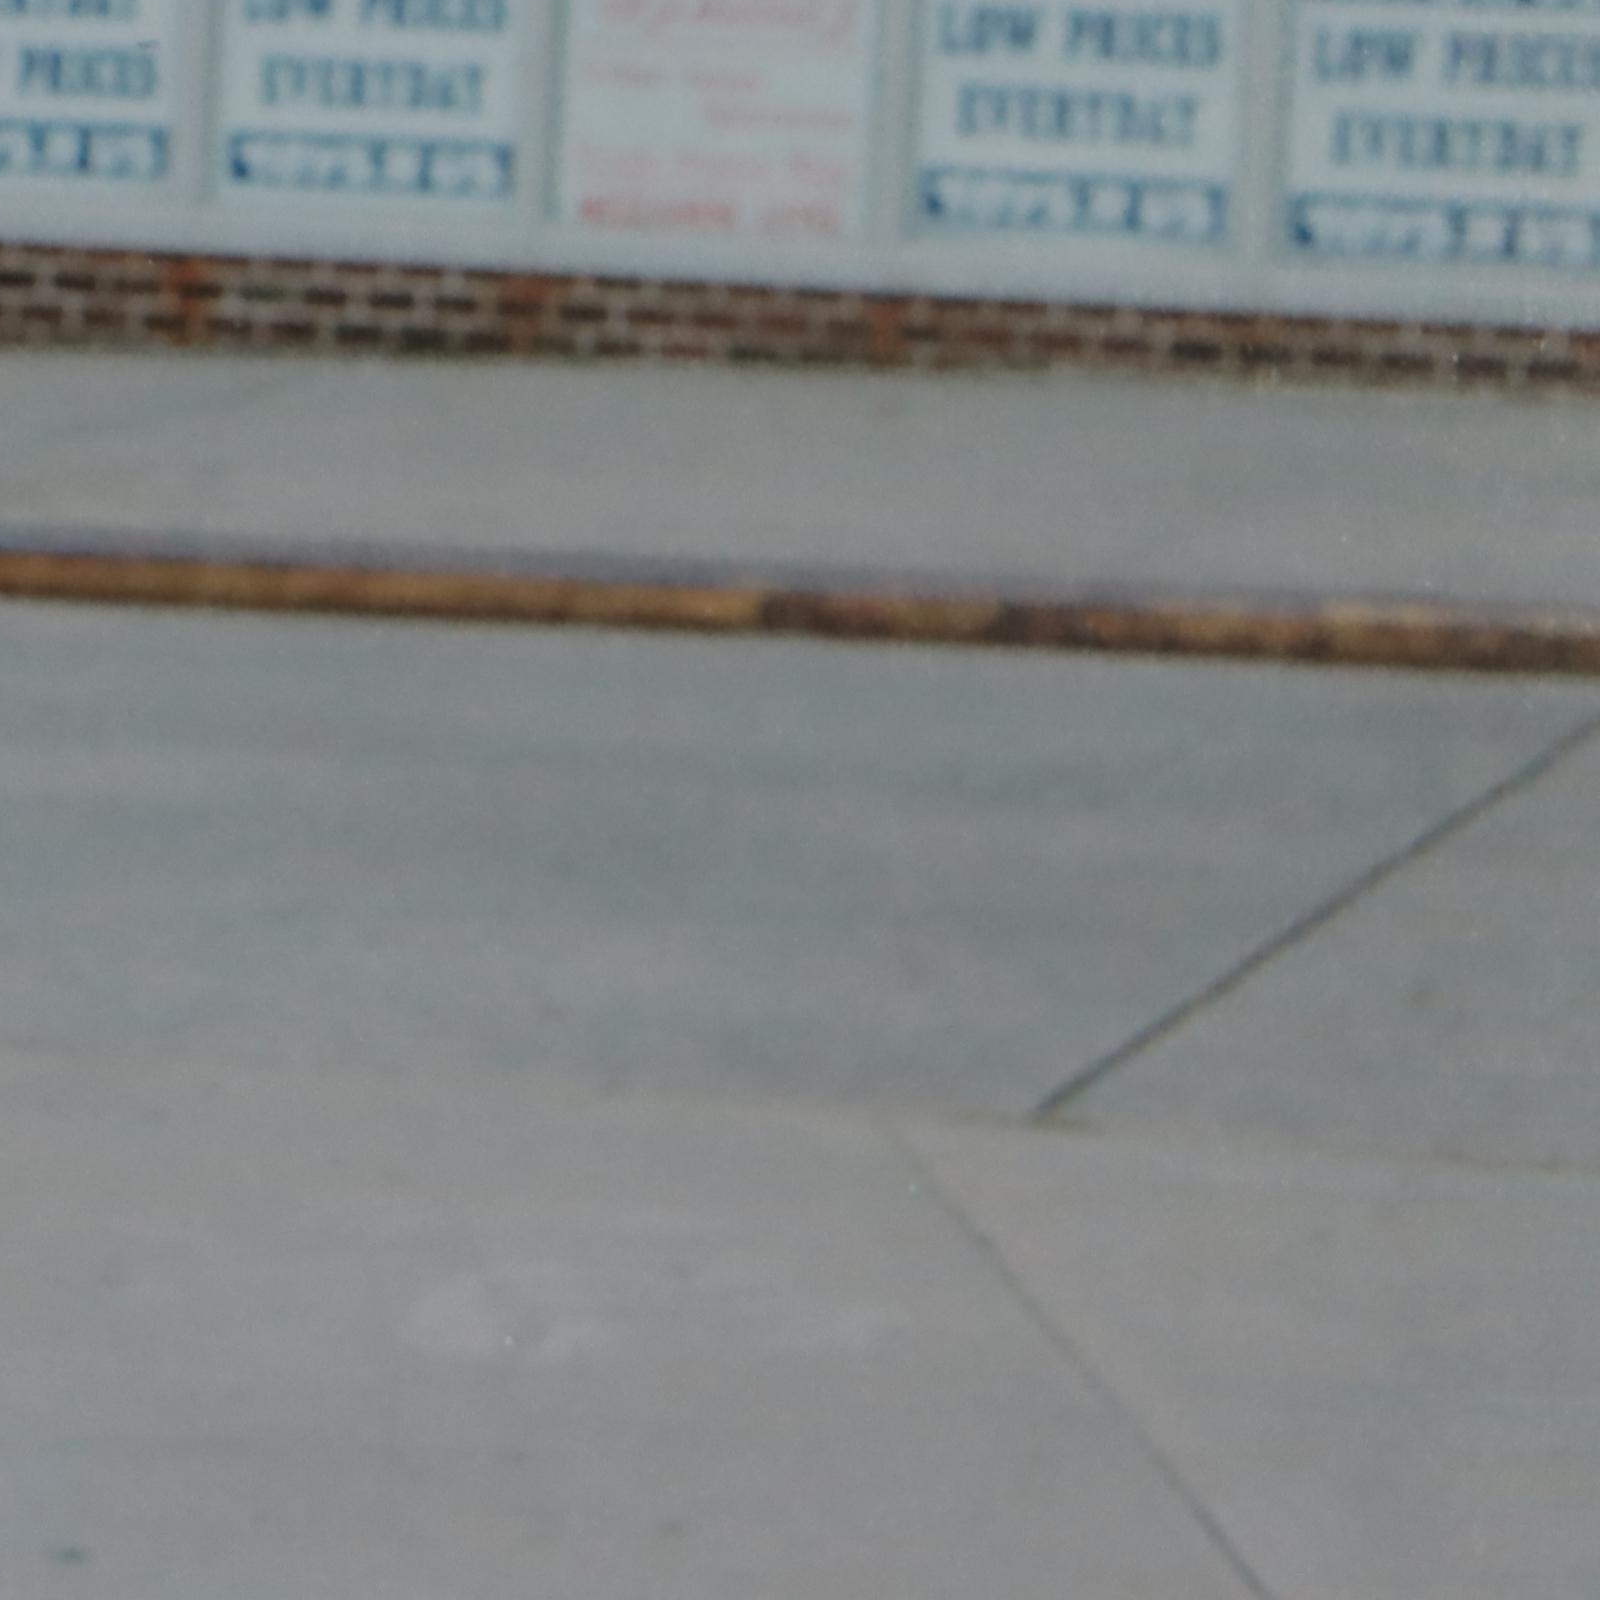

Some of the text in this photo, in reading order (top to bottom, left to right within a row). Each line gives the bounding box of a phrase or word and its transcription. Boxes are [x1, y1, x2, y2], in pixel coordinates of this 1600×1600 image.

[939, 3, 1223, 71] LOW PRICES
[1314, 27, 1415, 84] LOW
[18, 47, 158, 97] PRICES
[260, 53, 487, 112] EVERYDAY
[957, 82, 1200, 148] EVERYDAY
[1329, 109, 1584, 176] EVERYDAY
